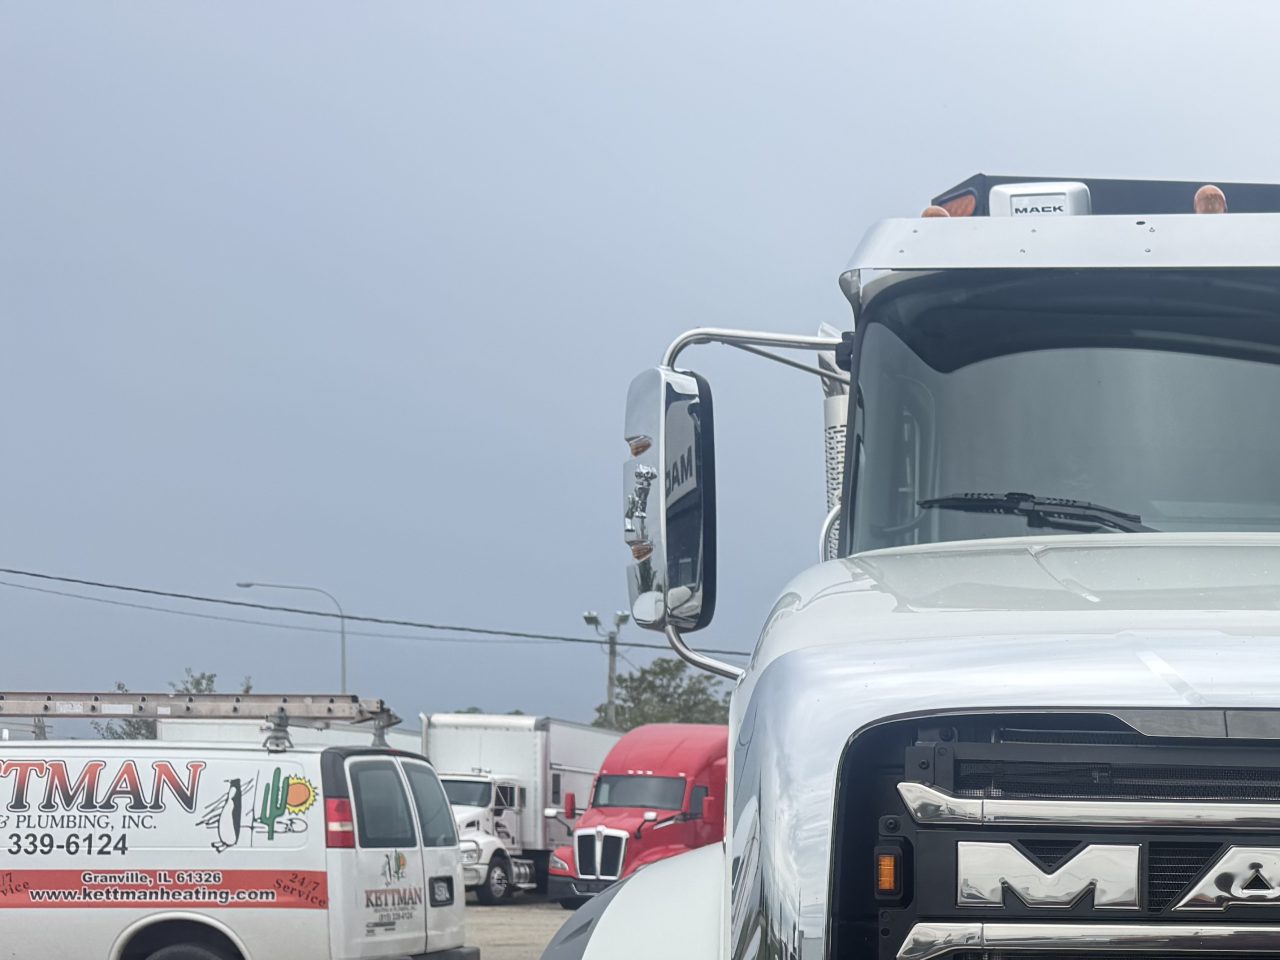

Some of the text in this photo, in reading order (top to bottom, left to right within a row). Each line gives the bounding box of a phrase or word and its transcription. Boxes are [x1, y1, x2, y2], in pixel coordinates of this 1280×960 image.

[1014, 205, 1064, 214] MACK
[0, 759, 206, 813] TMAN
[15, 814, 115, 831] PLUMBING,
[121, 815, 157, 830] INC.
[7, 832, 129, 856] 339-6124
[82, 872, 222, 886] Granville, IL 61326
[289, 873, 320, 891] 24/7
[29, 887, 276, 904] www.kettmanheating.com
[273, 879, 326, 907] Service
[365, 887, 422, 908] KETTMAN
